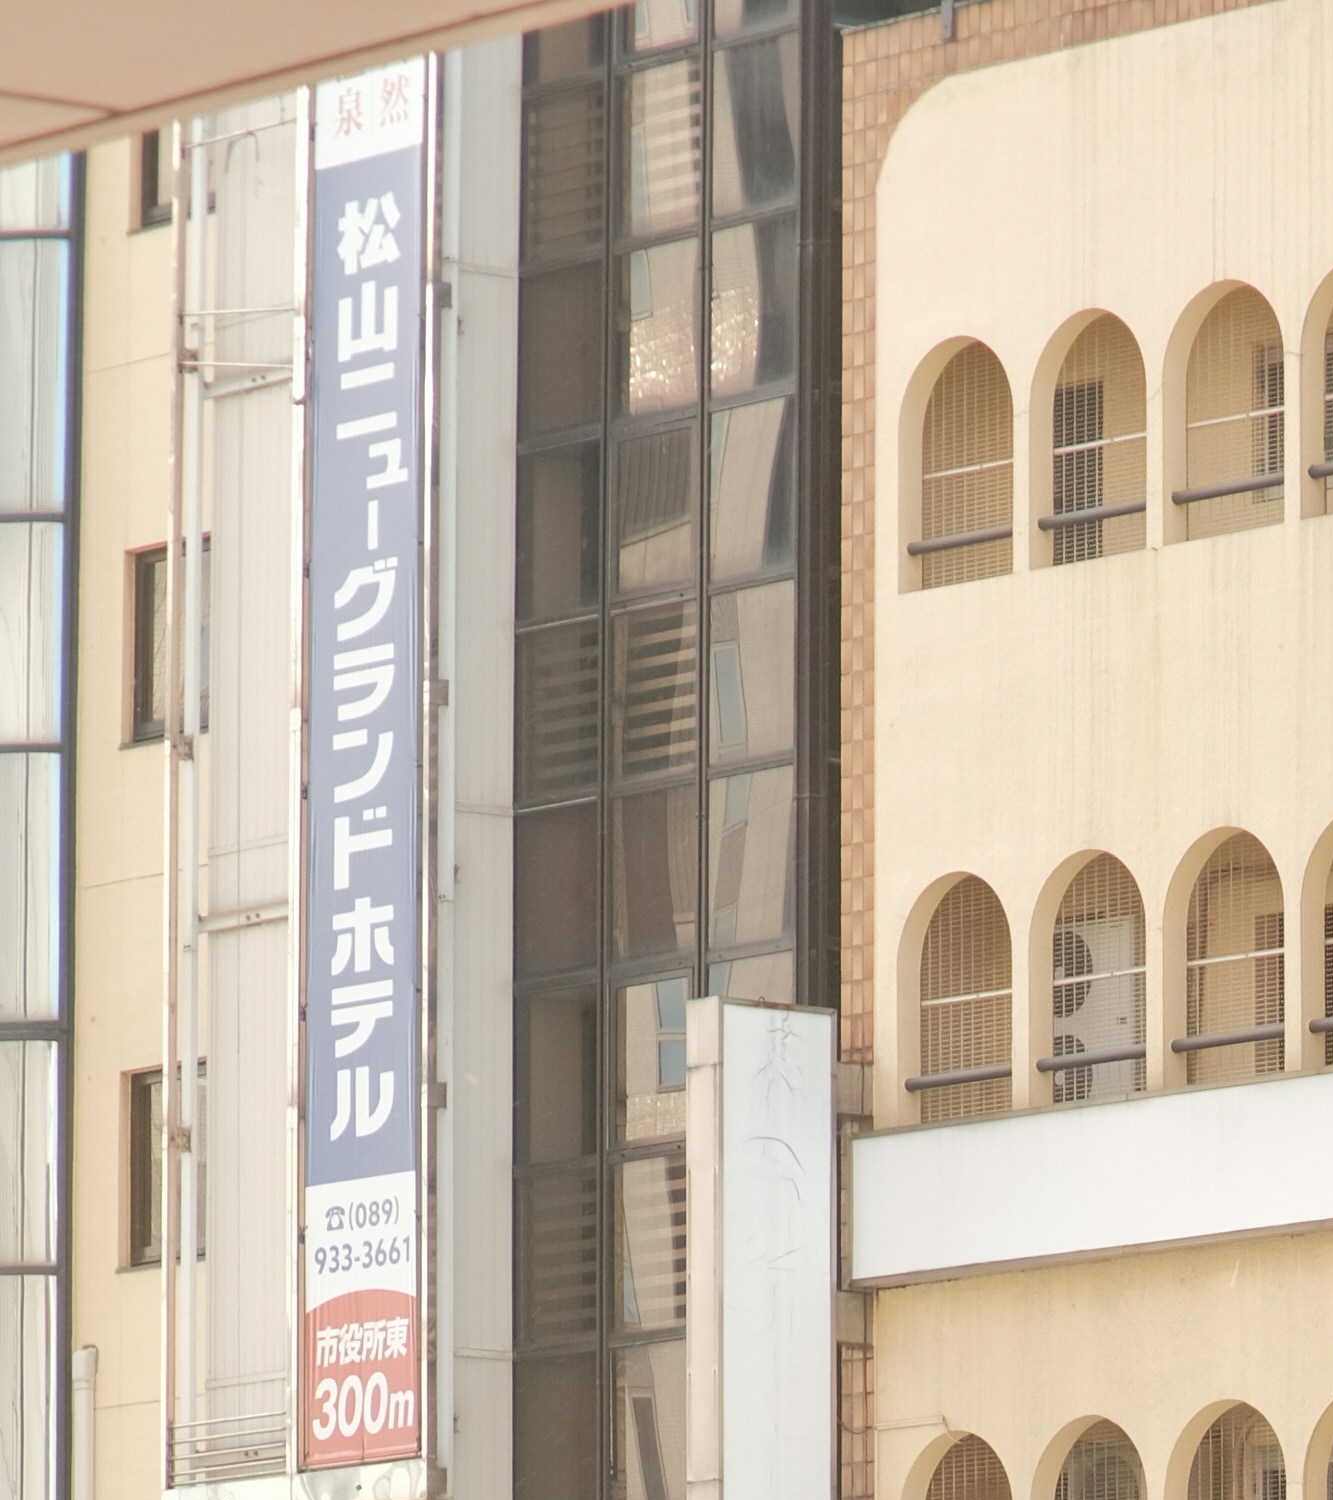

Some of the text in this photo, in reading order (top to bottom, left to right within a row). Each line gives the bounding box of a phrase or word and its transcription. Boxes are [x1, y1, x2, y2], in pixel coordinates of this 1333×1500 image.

[329, 191, 409, 1143] 松山ニューグランドホテル
[314, 1235, 410, 1274] 933-3661
[316, 1316, 409, 1367] 市役所東
[312, 1371, 414, 1441] 300m
